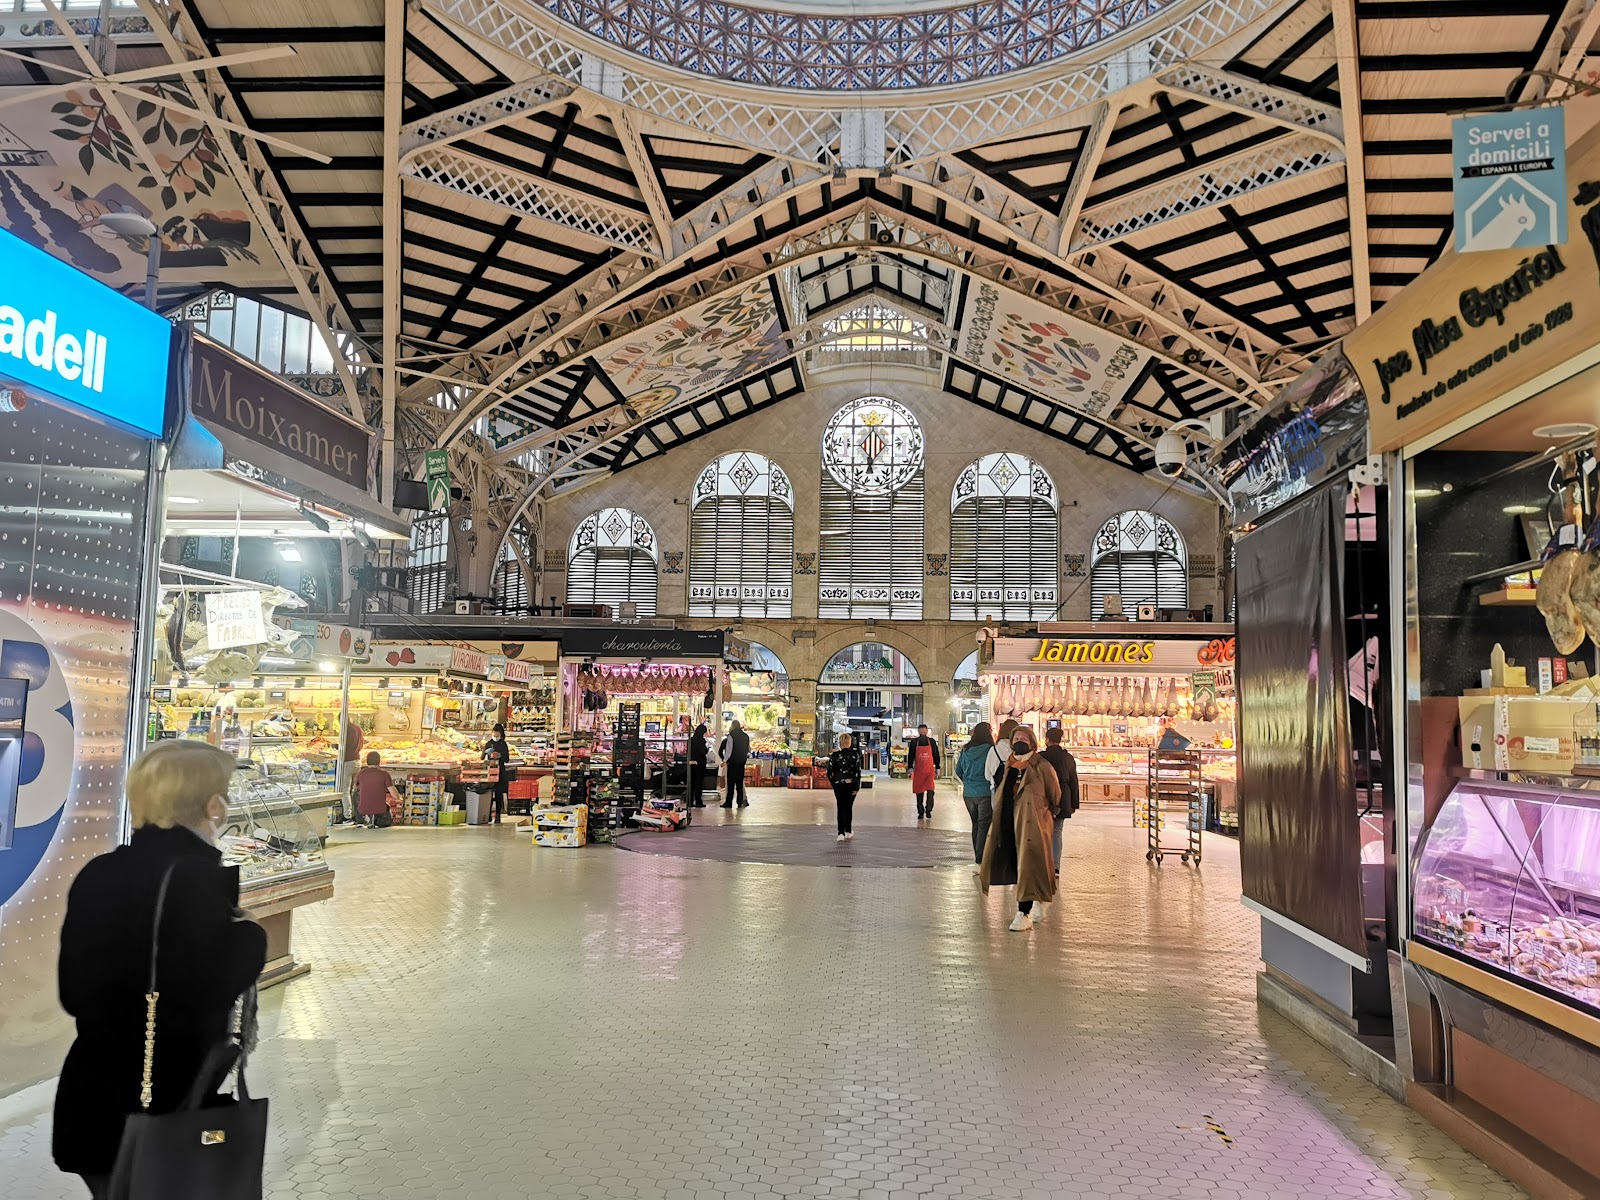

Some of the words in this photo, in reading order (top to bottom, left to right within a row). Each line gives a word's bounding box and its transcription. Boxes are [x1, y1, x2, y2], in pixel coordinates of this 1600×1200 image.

[1468, 122, 1531, 145] Servei
[1537, 124, 1549, 137] a
[1469, 140, 1550, 166] domicili
[1481, 166, 1512, 175] ESPANYA
[1519, 161, 1548, 171] EUROPA
[1459, 244, 1567, 328] Español
[0, 304, 107, 393] adell
[196, 356, 358, 477] Moixamer
[216, 594, 252, 609] PRECIOS
[208, 609, 243, 624] DIRECTOS
[248, 609, 257, 619] DE
[453, 651, 483, 671] VIRGINIA
[1032, 638, 1155, 663] Jamones
[504, 662, 530, 680] IRGIN
